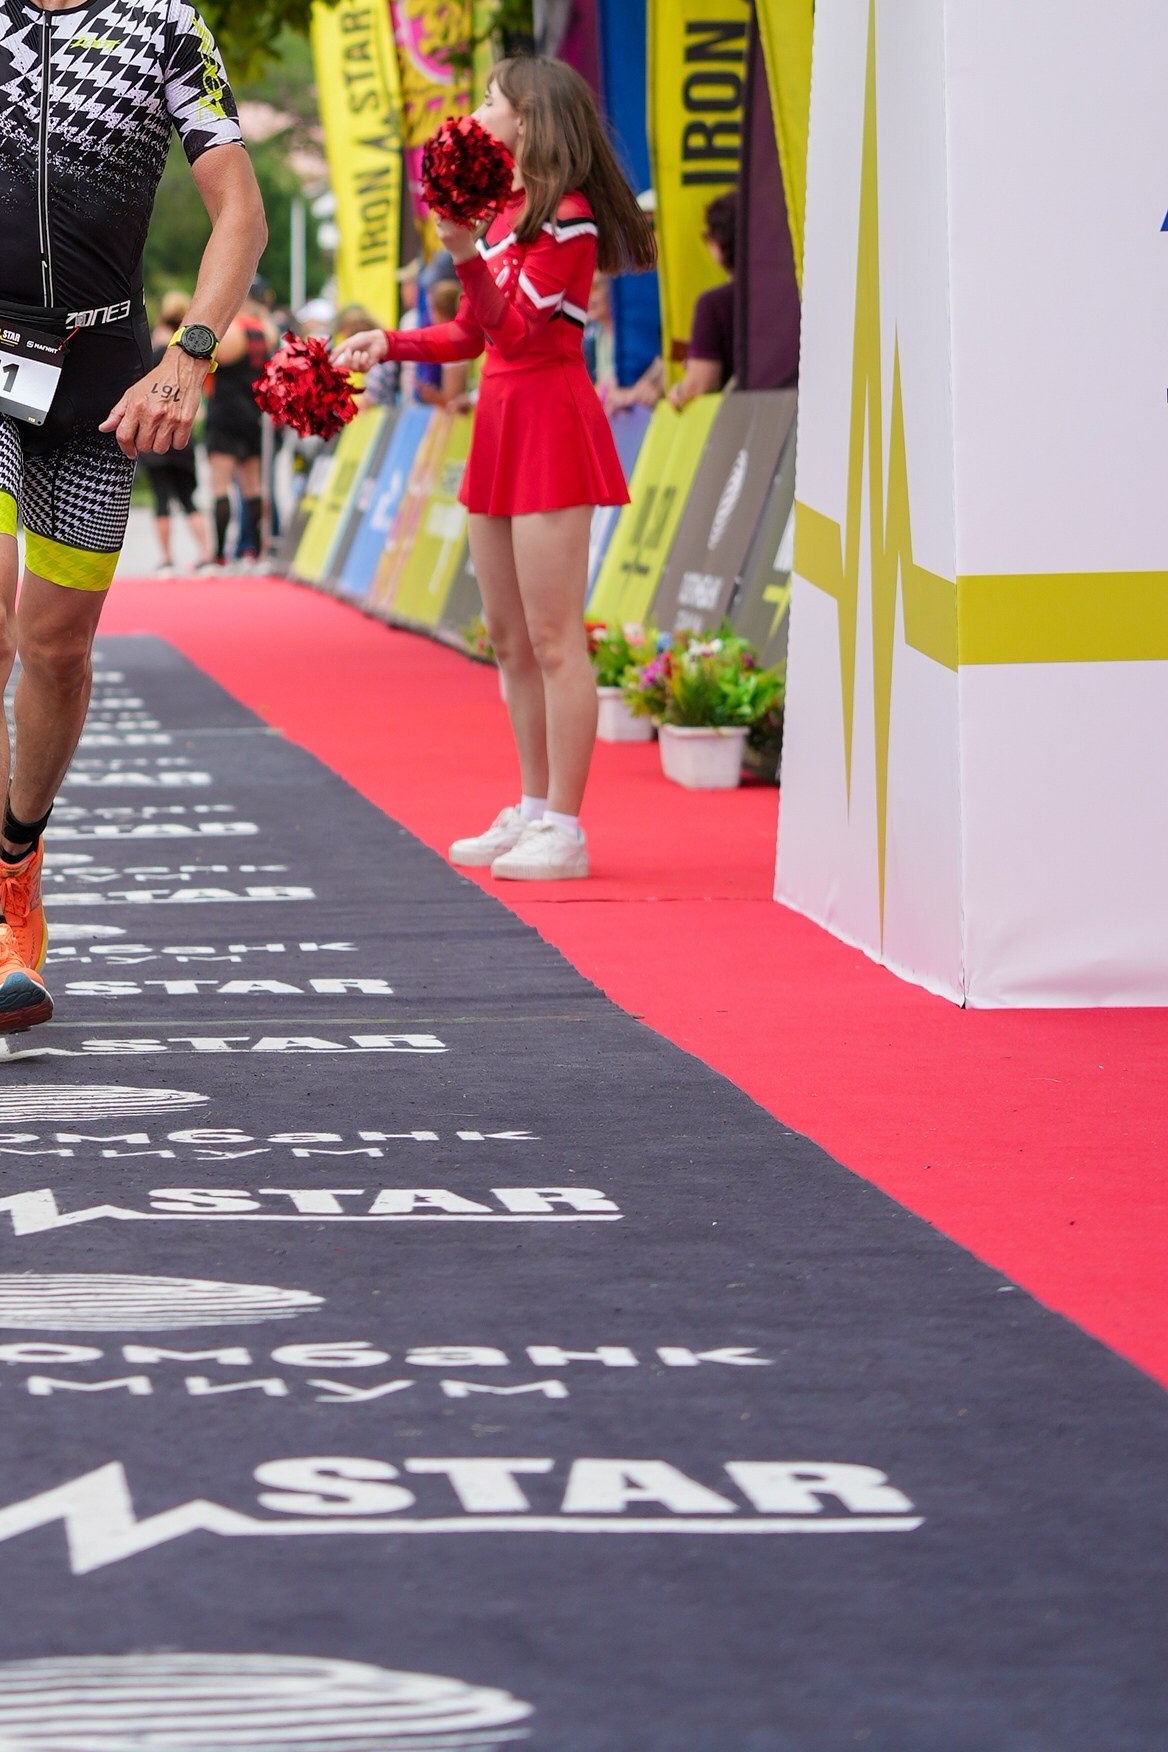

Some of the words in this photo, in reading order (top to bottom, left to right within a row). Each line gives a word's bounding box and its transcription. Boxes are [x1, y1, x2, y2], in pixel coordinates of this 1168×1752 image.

[339, 3, 382, 116] STAR
[680, 20, 750, 187] IRON
[354, 162, 393, 269] IRON
[2, 329, 21, 343] STAR
[64, 978, 394, 996] STAR
[81, 1033, 447, 1052] STAR
[147, 1187, 621, 1214] STAR
[252, 1456, 915, 1516] STAR
